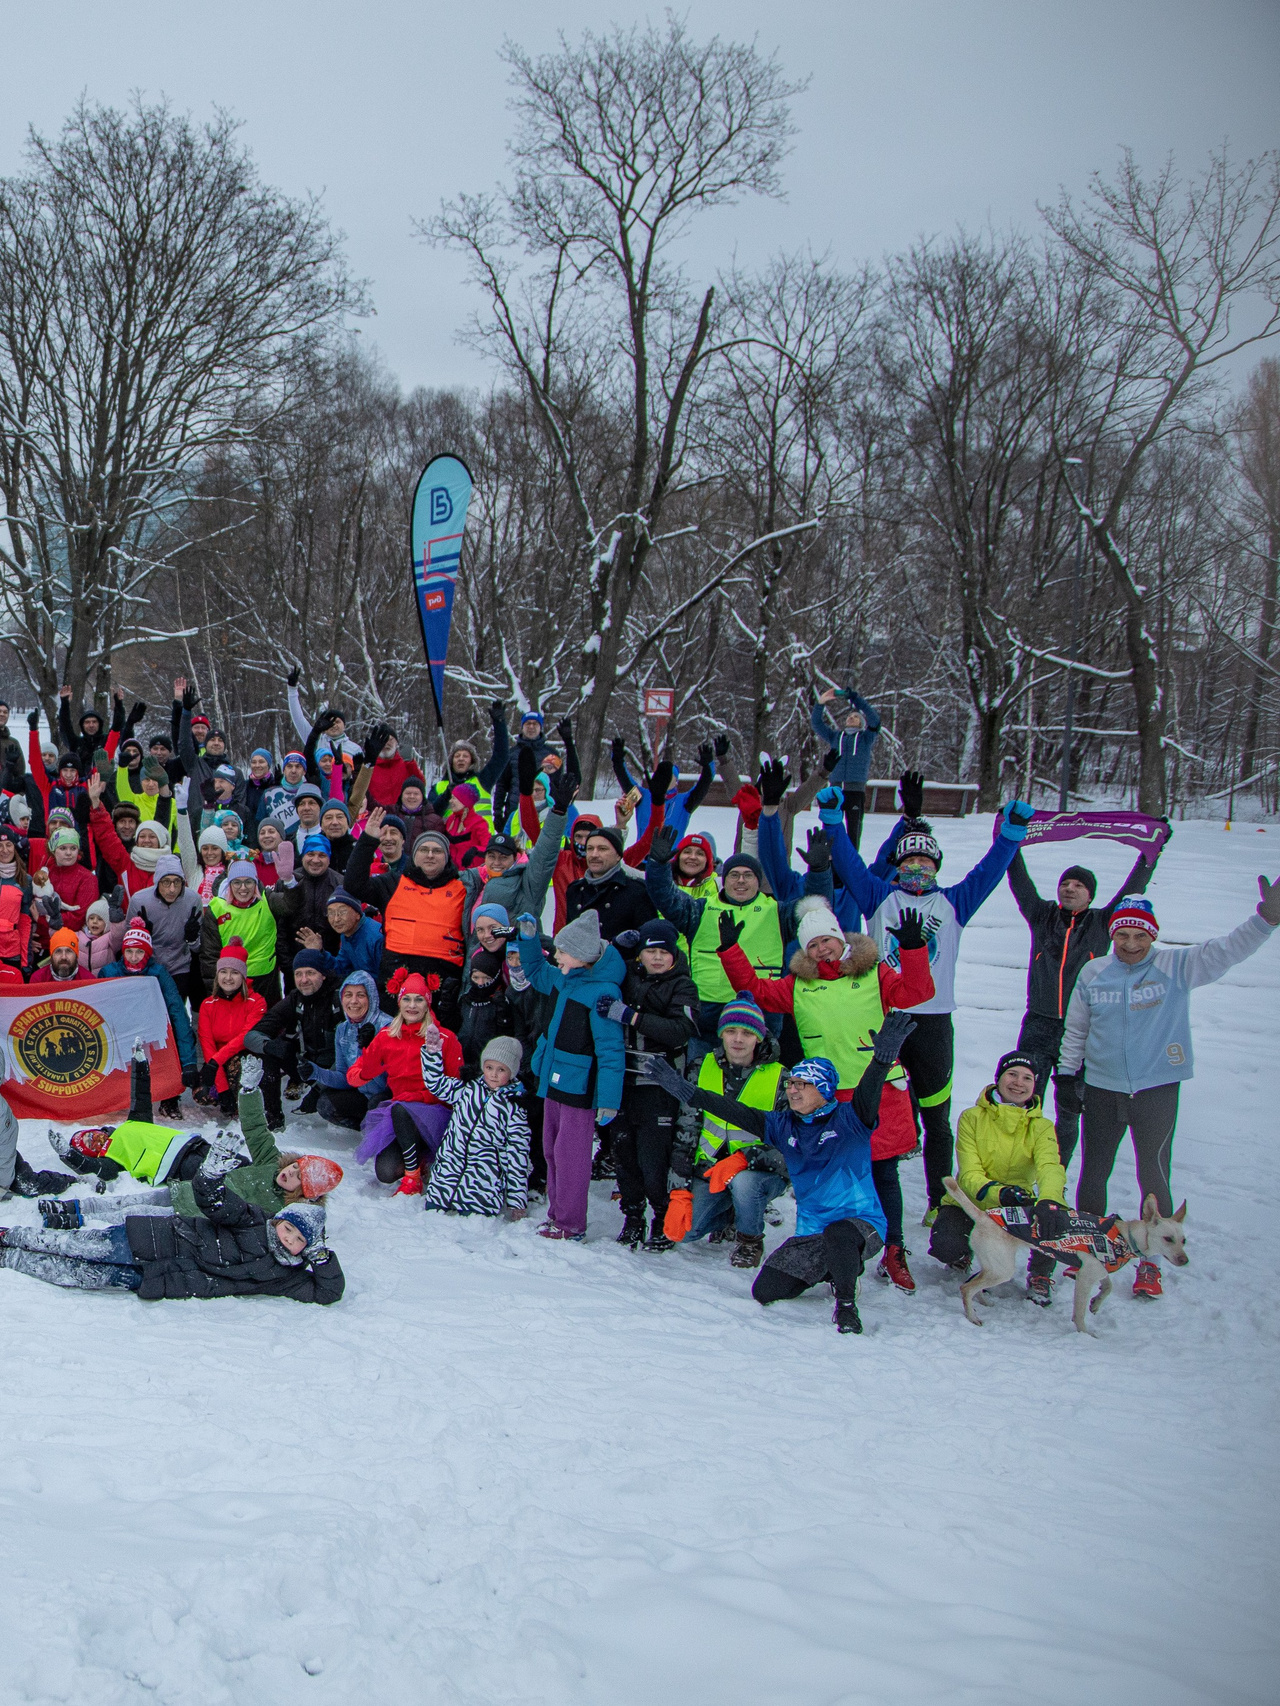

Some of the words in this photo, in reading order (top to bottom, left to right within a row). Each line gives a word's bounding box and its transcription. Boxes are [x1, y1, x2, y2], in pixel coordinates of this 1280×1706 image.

[12, 1002, 53, 1035] SPARTAK
[55, 1001, 101, 1026] MOSCOW
[26, 1018, 52, 1046] СКВАД
[73, 1050, 96, 1078] SQUAD
[1166, 1042, 1186, 1066] 9
[37, 1073, 101, 1096] SUPPORTERS
